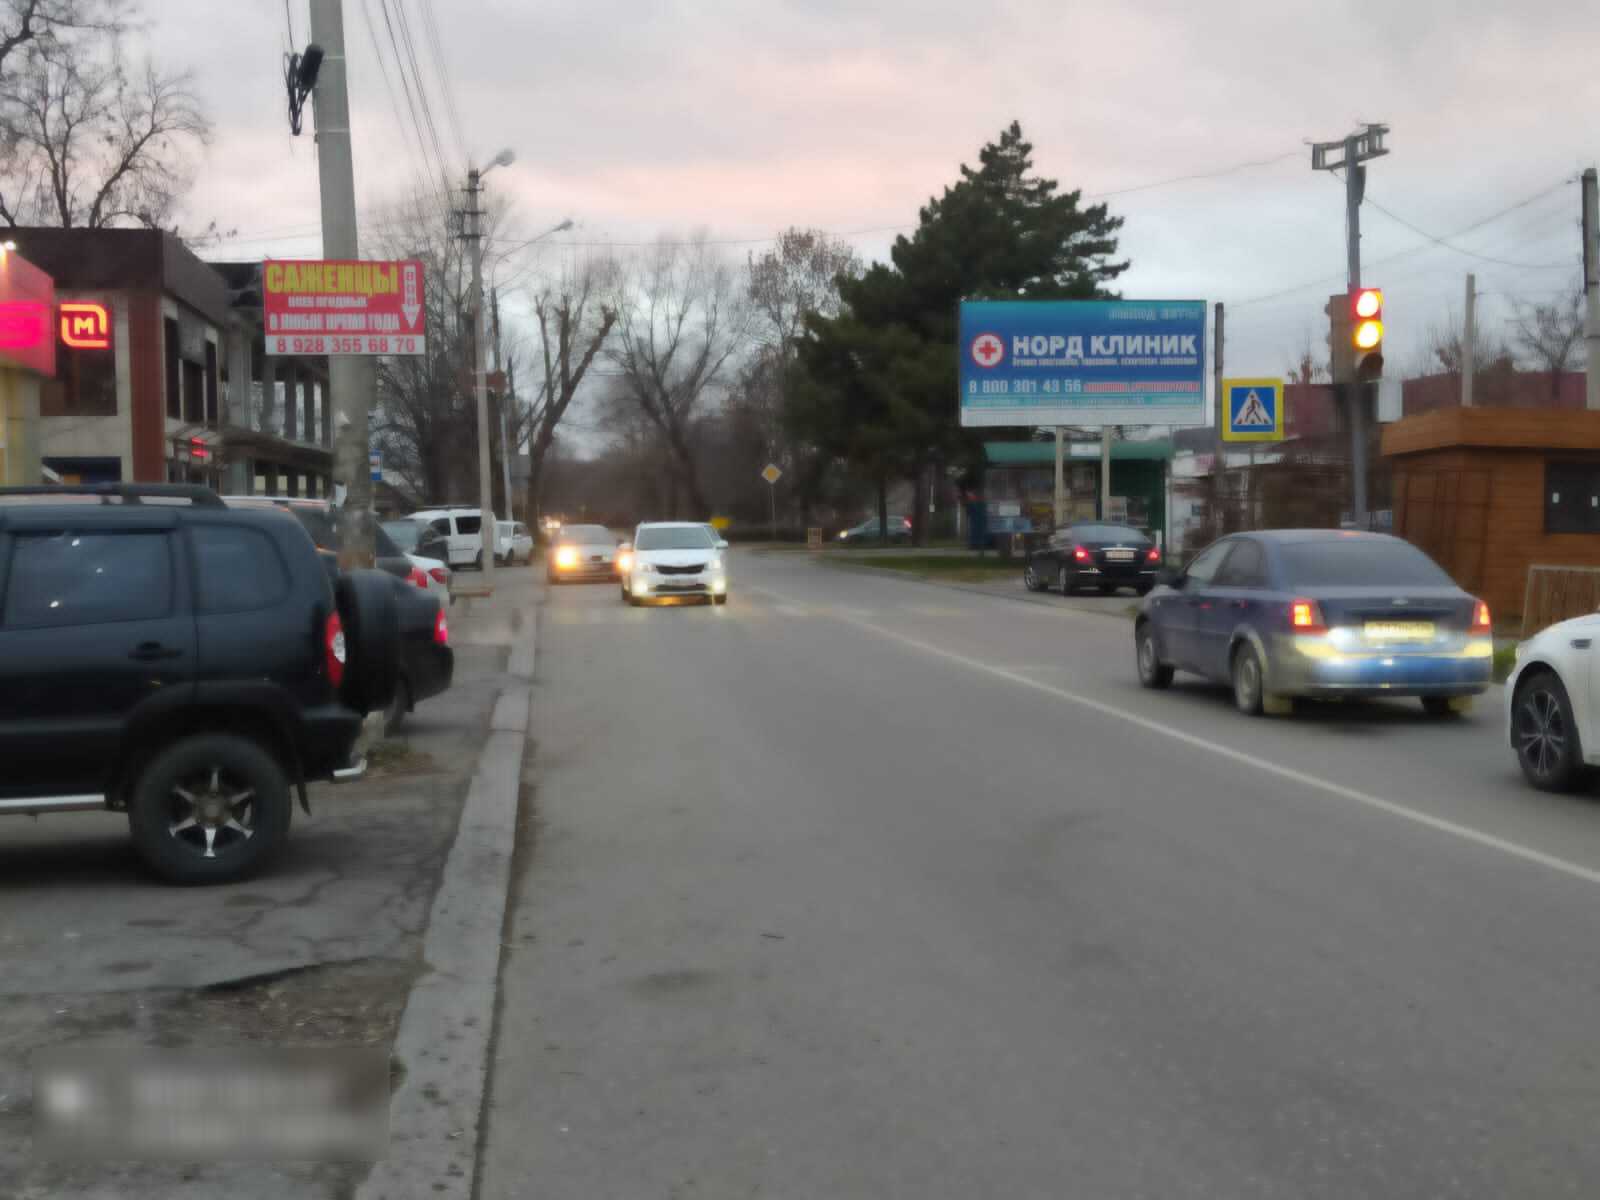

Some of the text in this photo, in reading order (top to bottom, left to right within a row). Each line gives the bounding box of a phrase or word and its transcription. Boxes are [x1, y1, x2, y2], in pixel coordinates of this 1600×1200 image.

[267, 263, 400, 297] САЖЕНЦЫ
[276, 338, 416, 353] 8 928 355 68 70
[1013, 335, 1198, 358] НОРД КЛИНИК
[969, 381, 977, 393] 8
